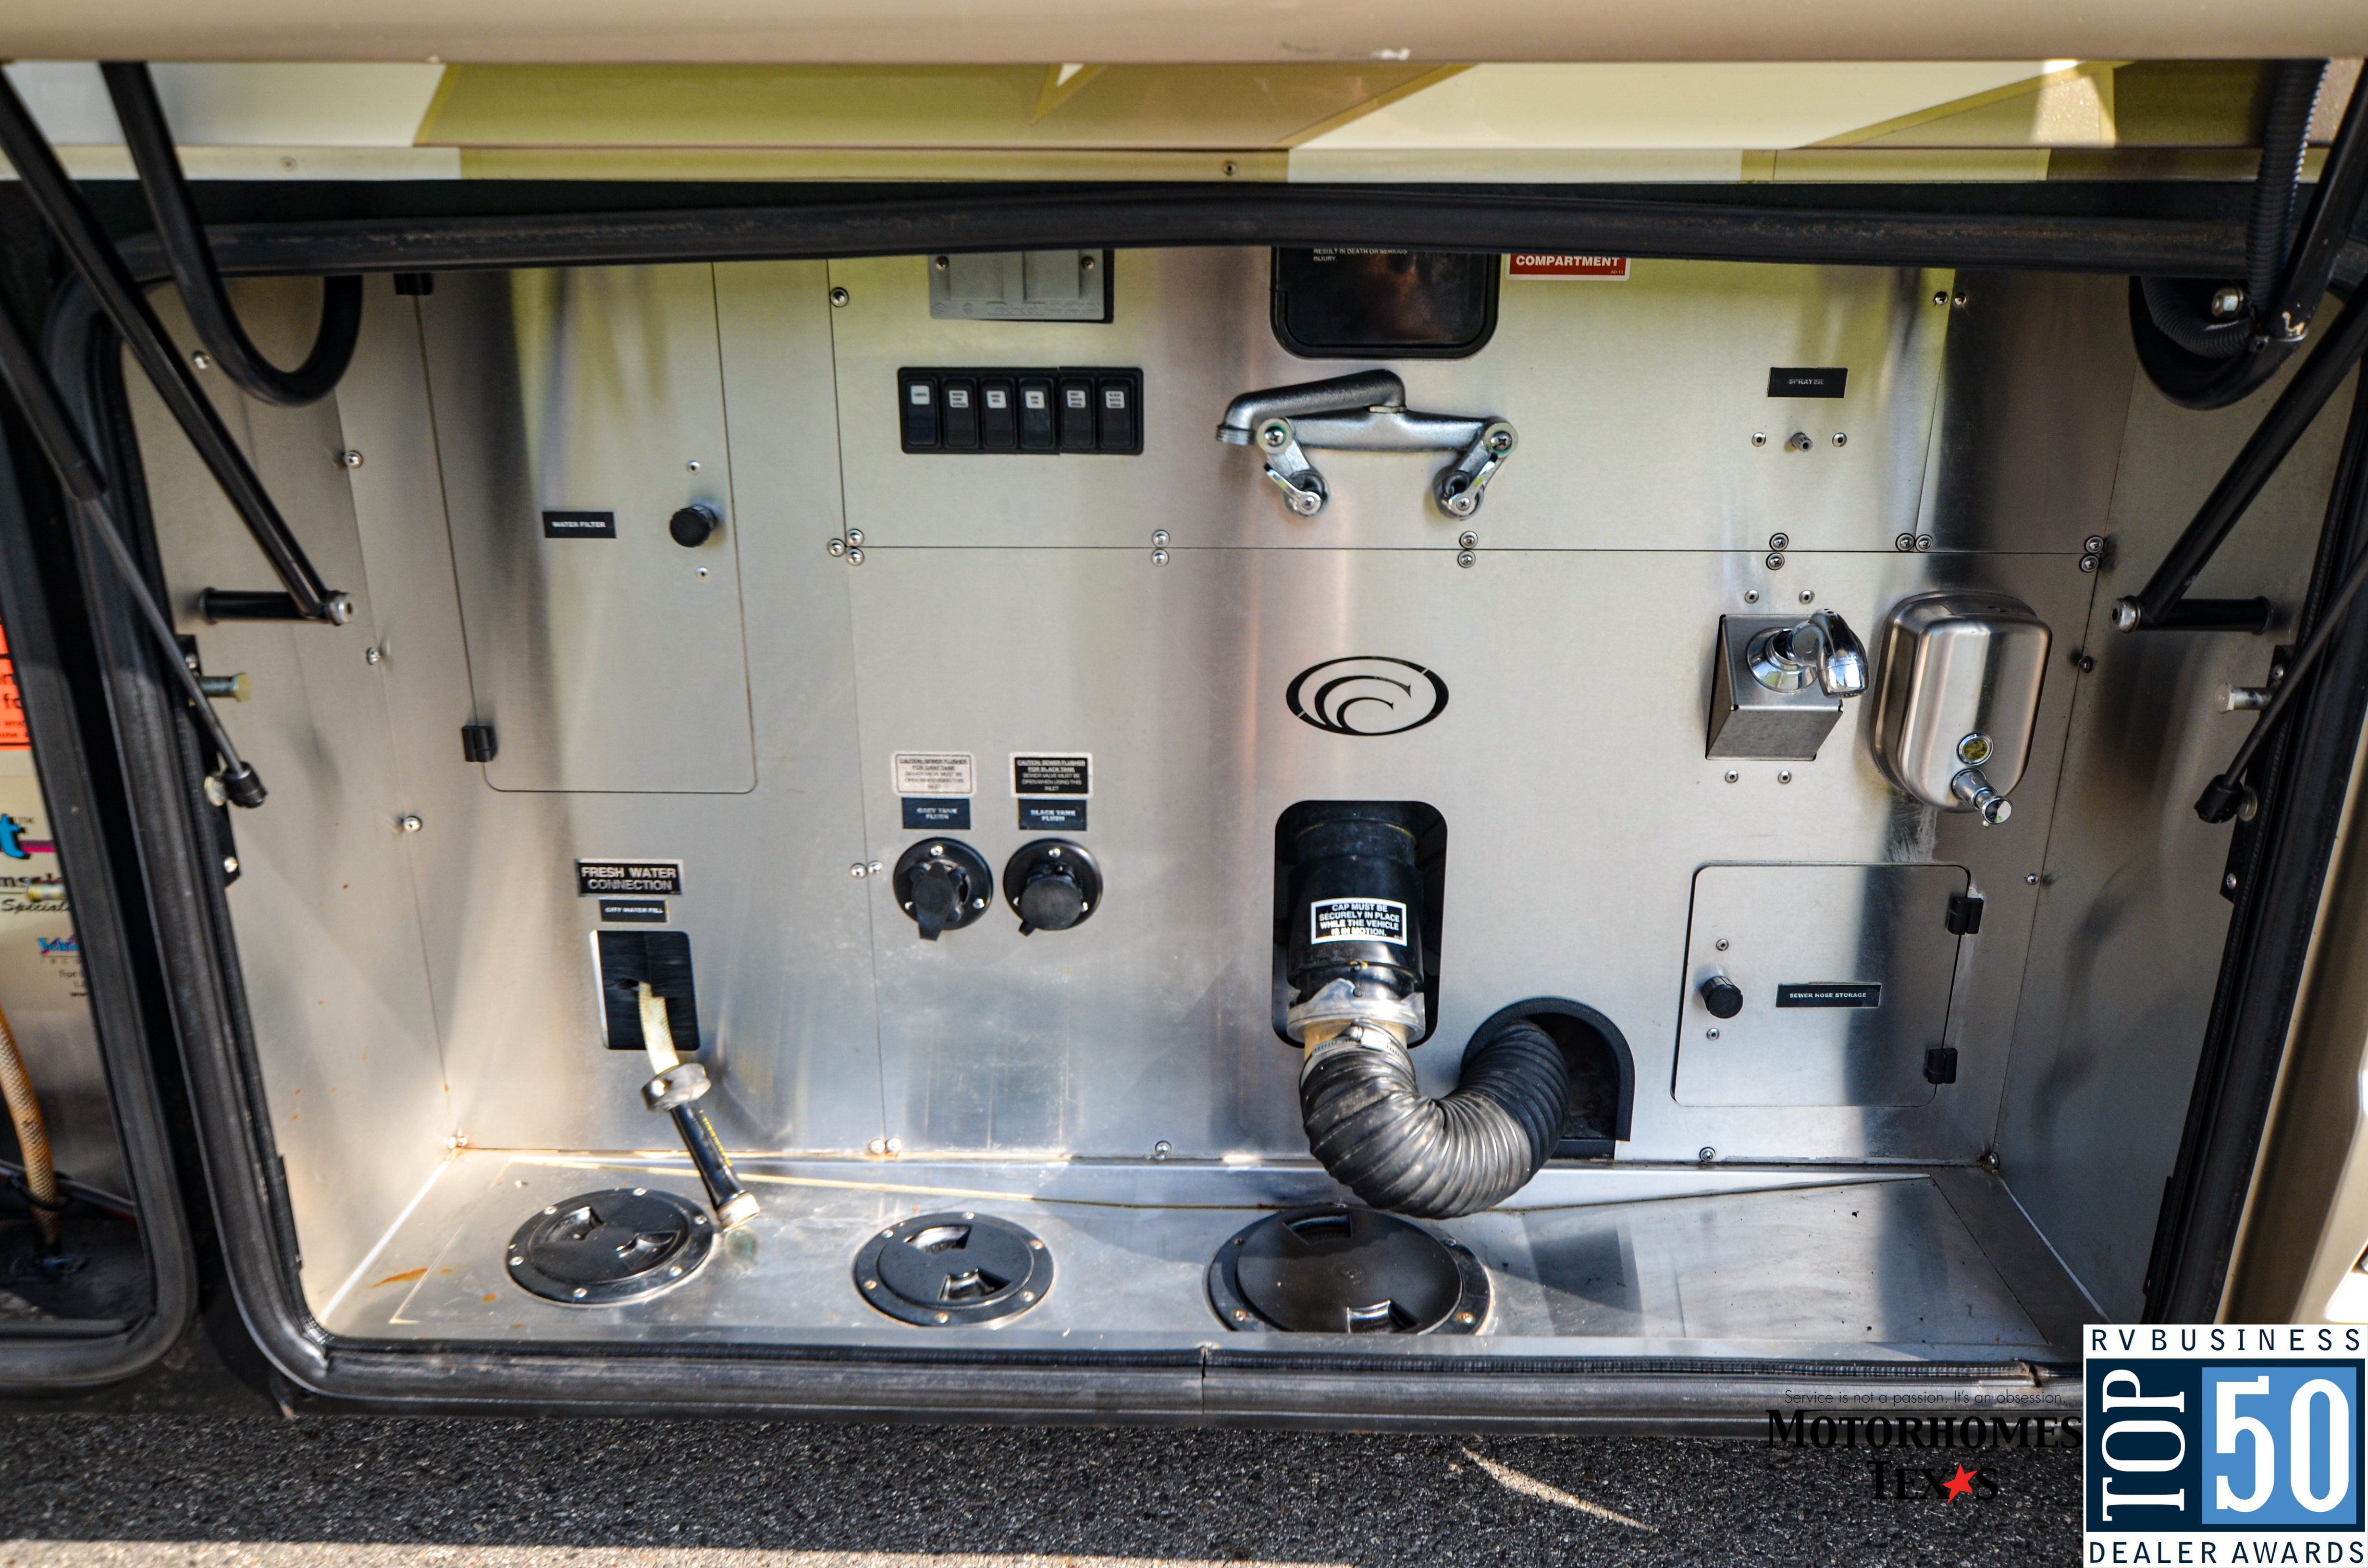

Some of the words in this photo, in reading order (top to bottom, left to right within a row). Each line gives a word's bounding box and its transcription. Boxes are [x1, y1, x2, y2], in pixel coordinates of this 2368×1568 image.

[1516, 255, 1620, 267] COMPARTMENT
[581, 866, 625, 878] FRESH
[628, 867, 677, 879] WATER
[587, 879, 673, 891] CONNECTION
[1331, 904, 1350, 912] CAP
[1351, 903, 1375, 912] MUST
[1376, 904, 1388, 912] BE
[1319, 911, 1363, 922] SECURELY
[1364, 911, 1373, 919] IN
[1374, 912, 1400, 923] PLACE
[1320, 919, 1346, 930] WHILE
[1347, 919, 1365, 927] THE
[1366, 919, 1399, 931] VEHICLE
[1331, 928, 1340, 936] IS
